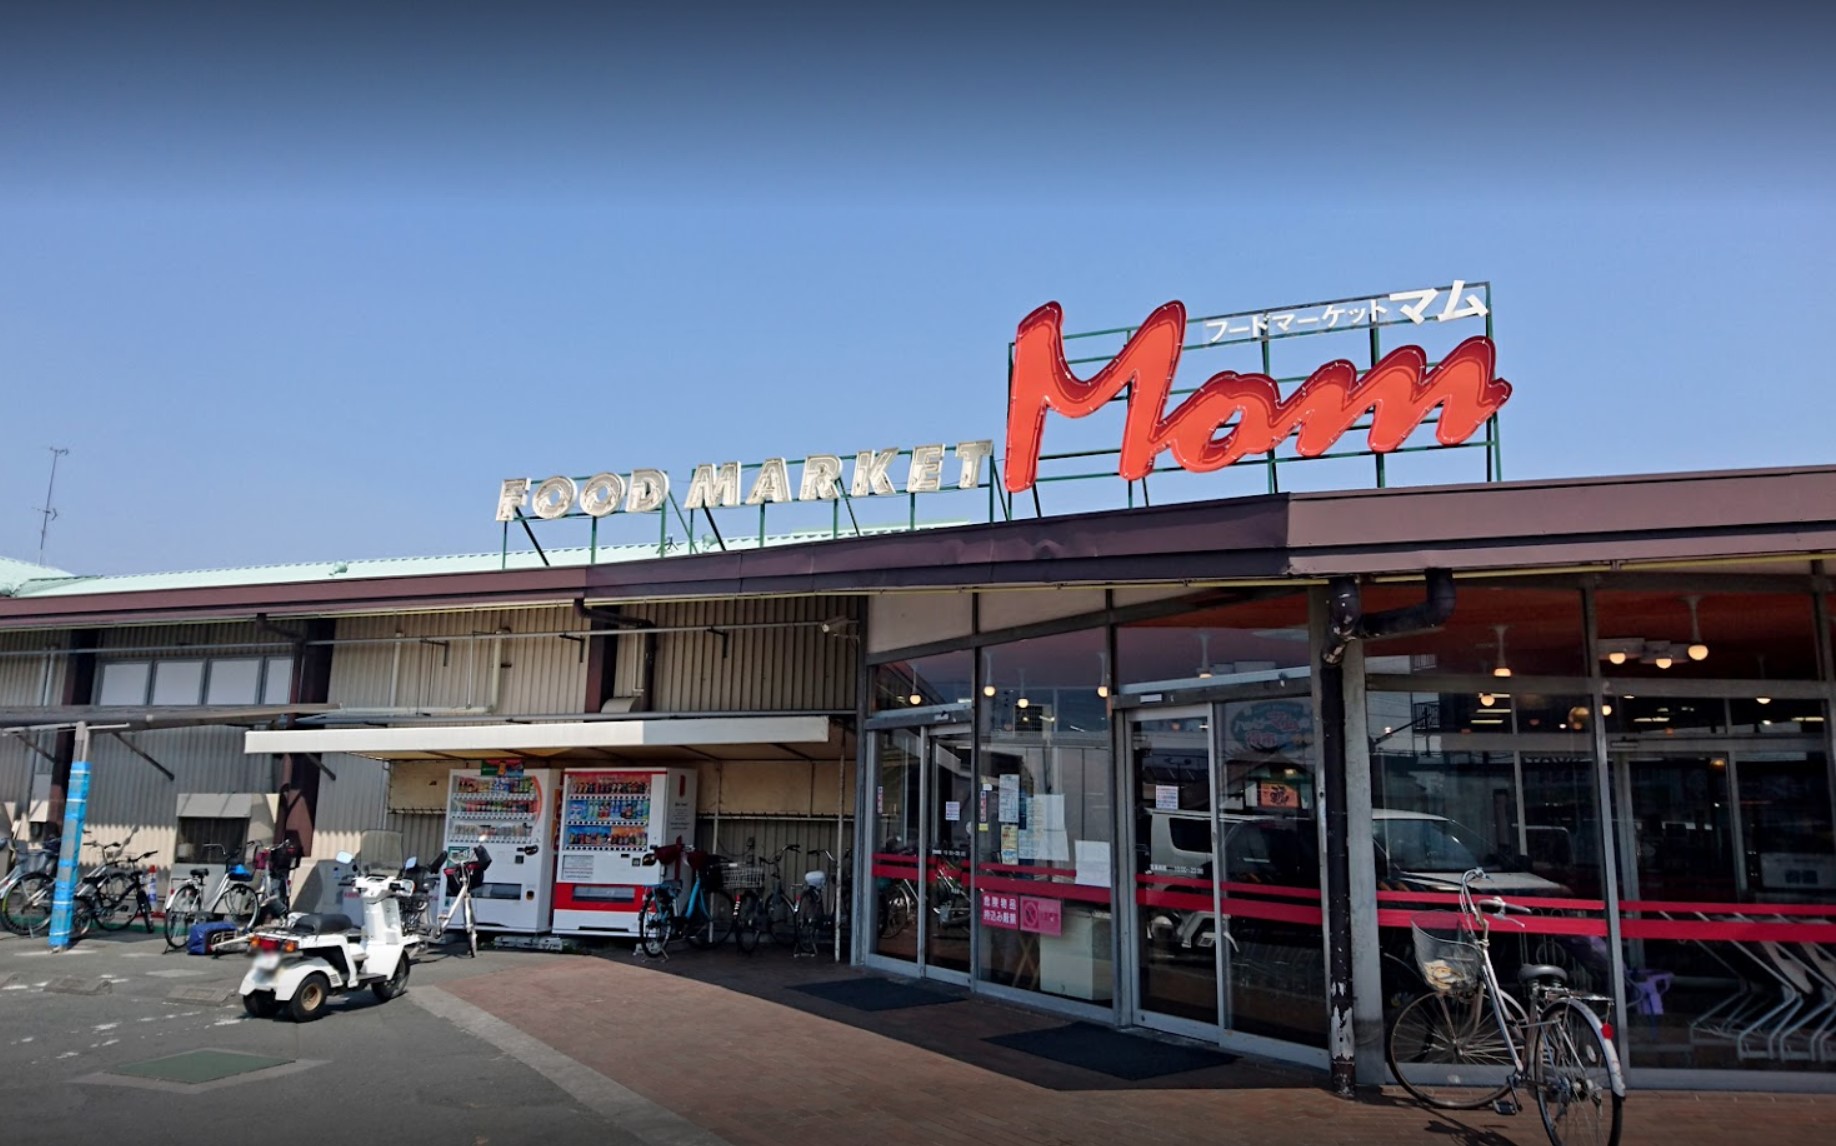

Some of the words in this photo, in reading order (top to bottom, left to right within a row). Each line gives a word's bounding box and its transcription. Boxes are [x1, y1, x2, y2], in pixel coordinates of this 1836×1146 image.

[1004, 300, 1513, 493] Mom
[495, 468, 670, 522] FOOD
[684, 439, 994, 509] MARKET
